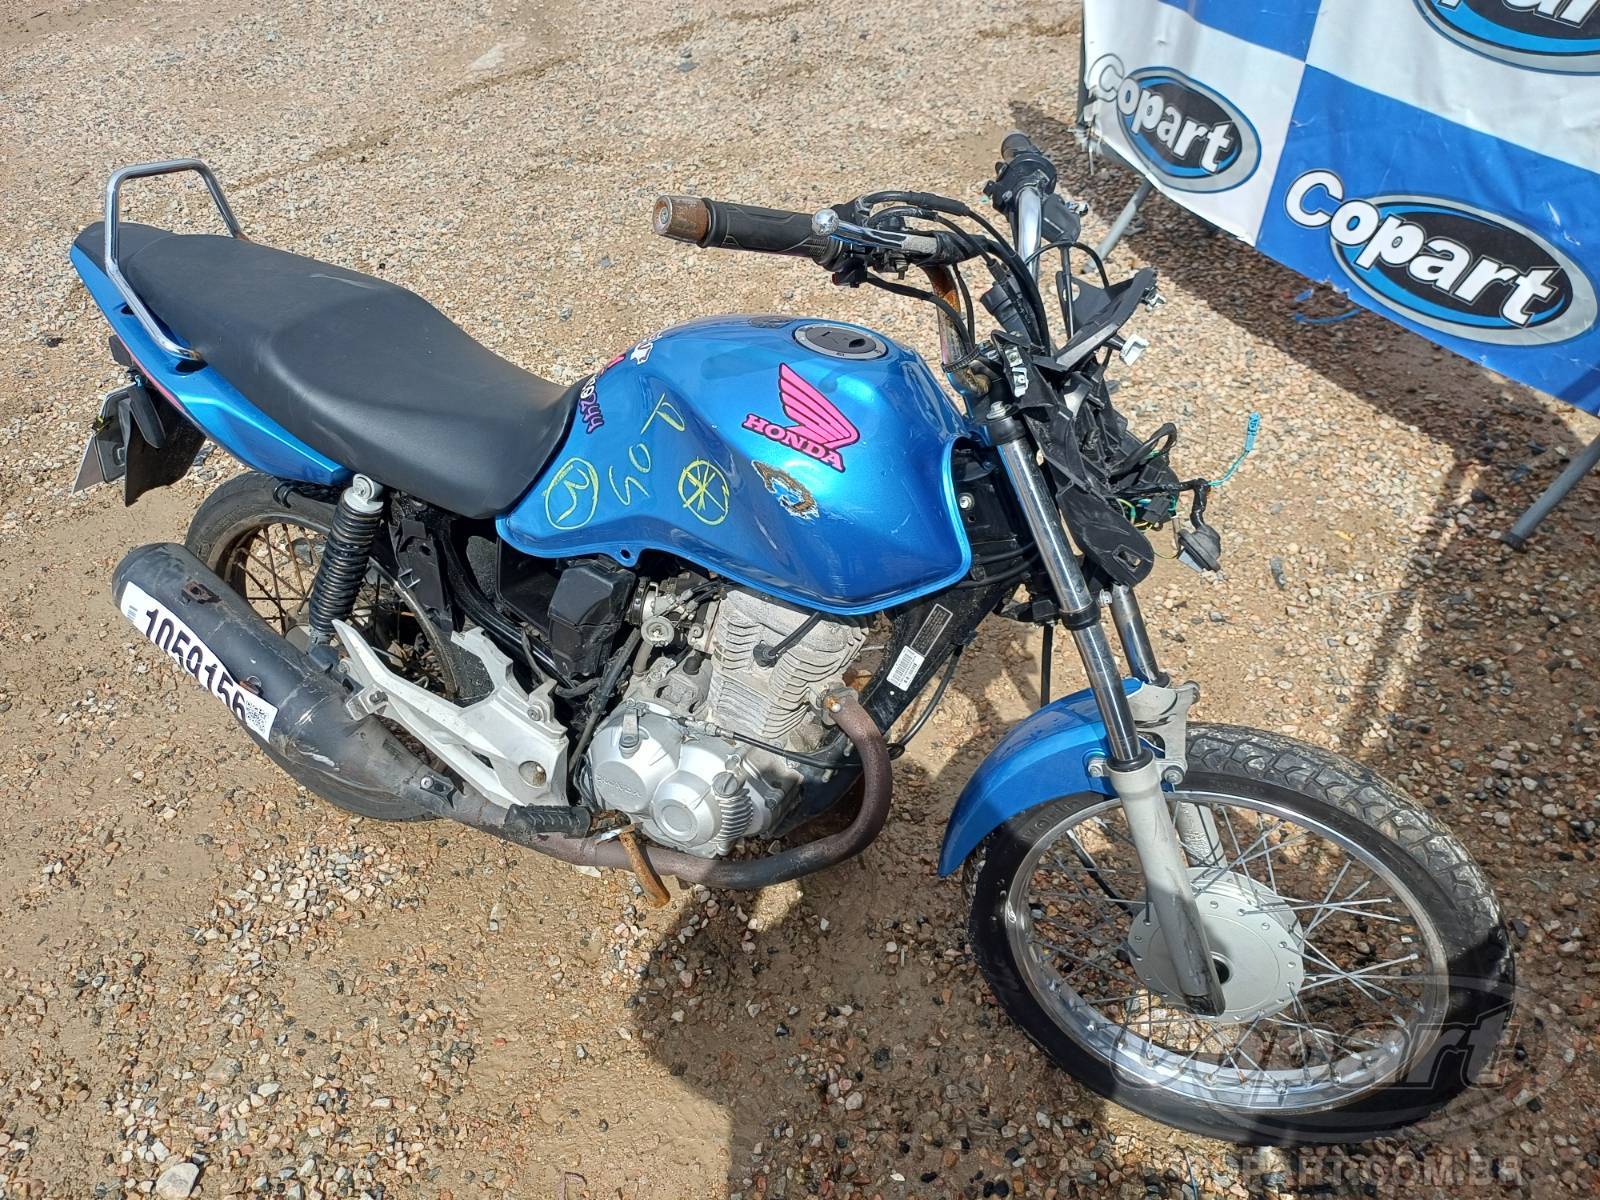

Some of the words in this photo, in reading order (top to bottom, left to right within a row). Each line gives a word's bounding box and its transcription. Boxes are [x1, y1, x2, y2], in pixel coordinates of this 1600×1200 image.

[1089, 52, 1234, 175] Copart
[1285, 168, 1565, 328] Copart
[742, 413, 845, 473] HONDA
